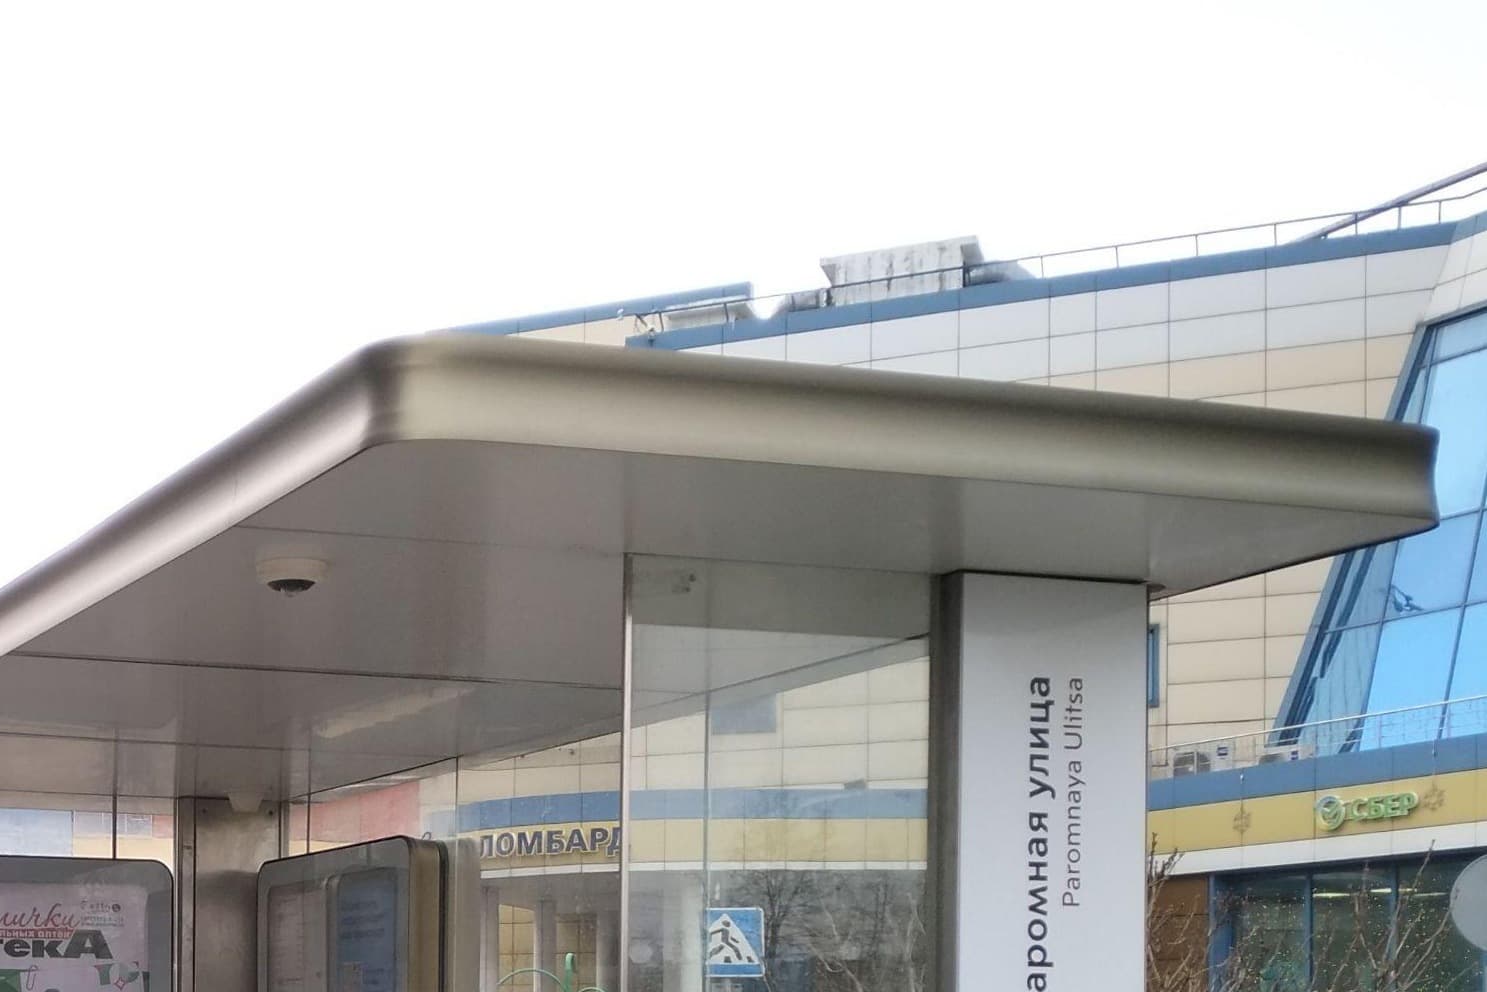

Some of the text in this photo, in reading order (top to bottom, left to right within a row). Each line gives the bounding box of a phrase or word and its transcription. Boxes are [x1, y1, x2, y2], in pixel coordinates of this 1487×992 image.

[1029, 676, 1056, 800] улица
[1063, 678, 1086, 906] Paromnaya Ulitsa
[1349, 793, 1416, 820] СБЕР
